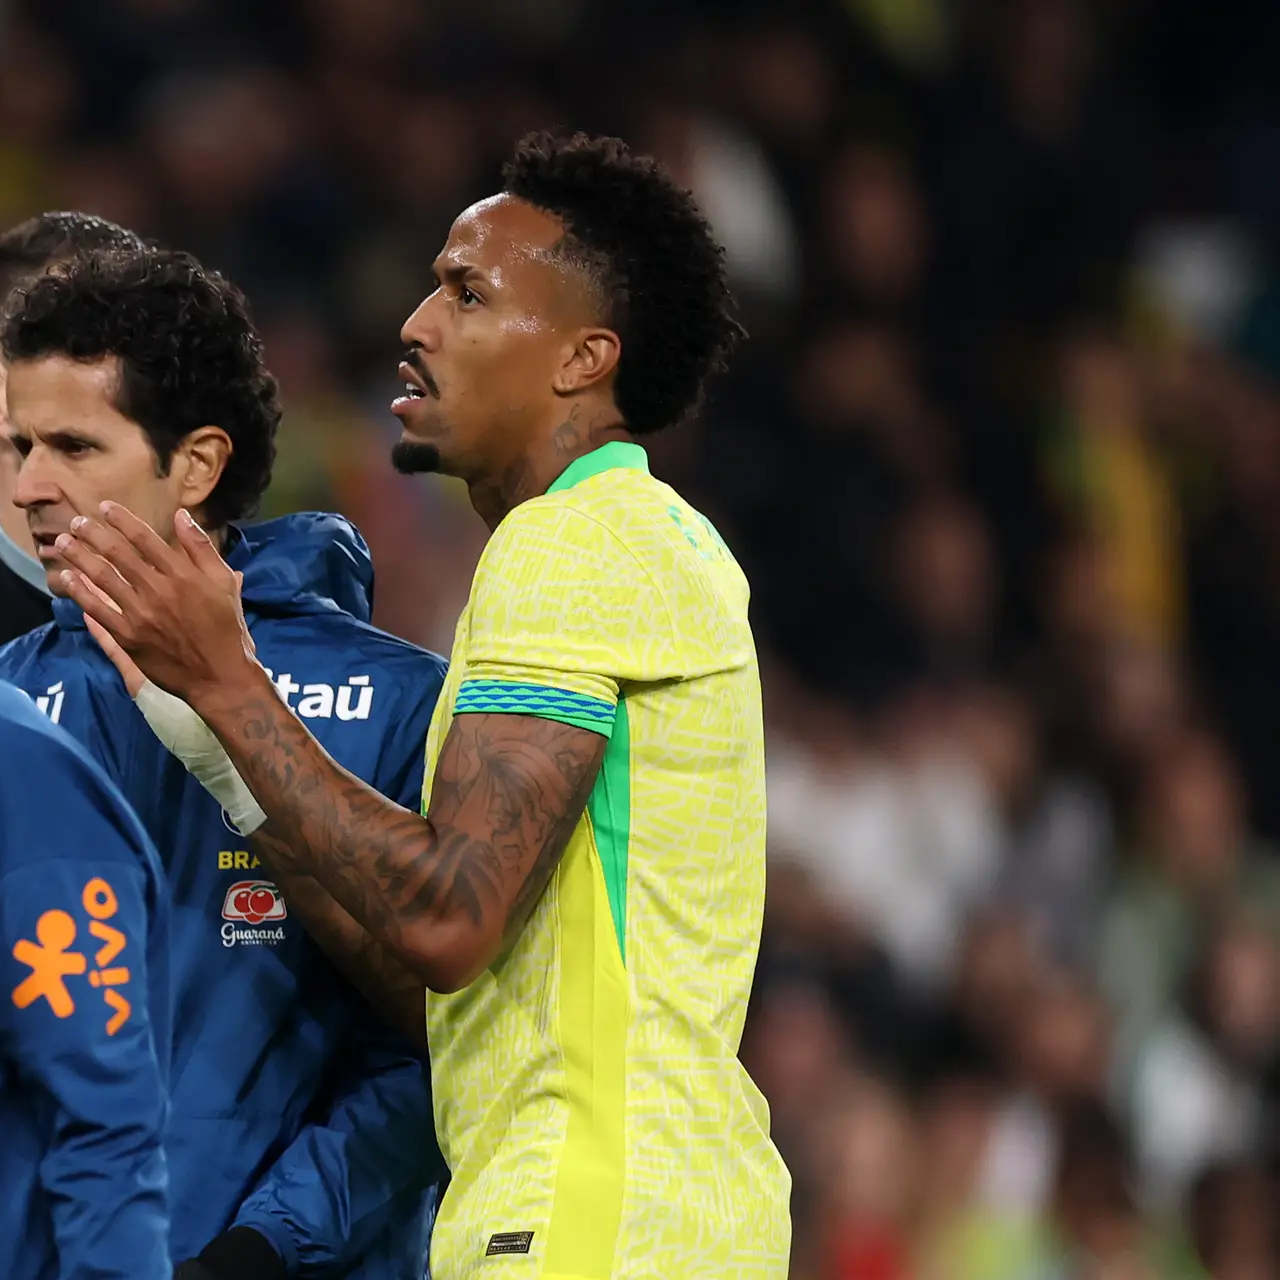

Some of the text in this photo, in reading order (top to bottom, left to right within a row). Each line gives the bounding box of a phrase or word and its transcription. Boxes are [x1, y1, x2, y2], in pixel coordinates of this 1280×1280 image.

[264, 668, 374, 721] taú
[217, 851, 261, 869] BRA
[221, 922, 285, 947] Guaraná
[82, 877, 131, 1036] vivo
